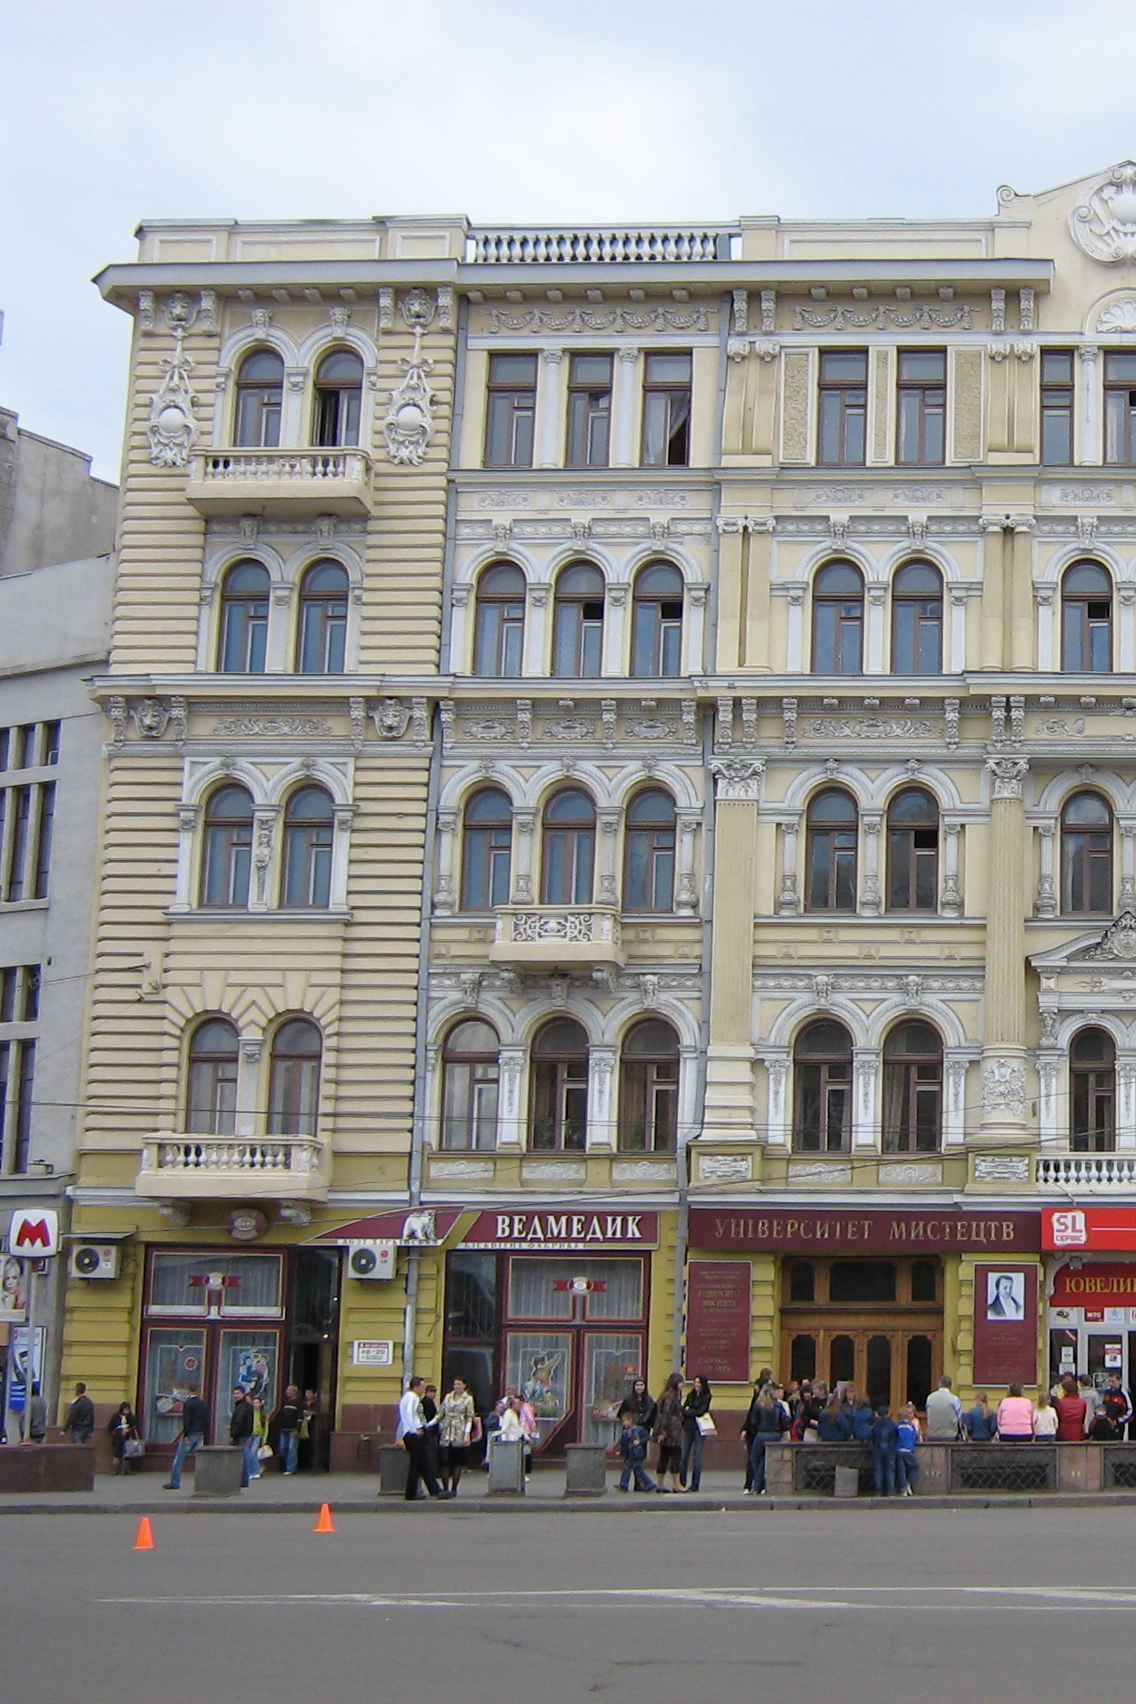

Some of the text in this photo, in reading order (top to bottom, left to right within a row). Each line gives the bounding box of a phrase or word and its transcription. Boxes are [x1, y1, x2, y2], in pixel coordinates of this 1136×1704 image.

[495, 1214, 643, 1242] ВЕДМЕДИК
[714, 1218, 1016, 1244] УНІВЕРСИТЕТ МИСТЕЦТВ
[1055, 1214, 1084, 1233] SL
